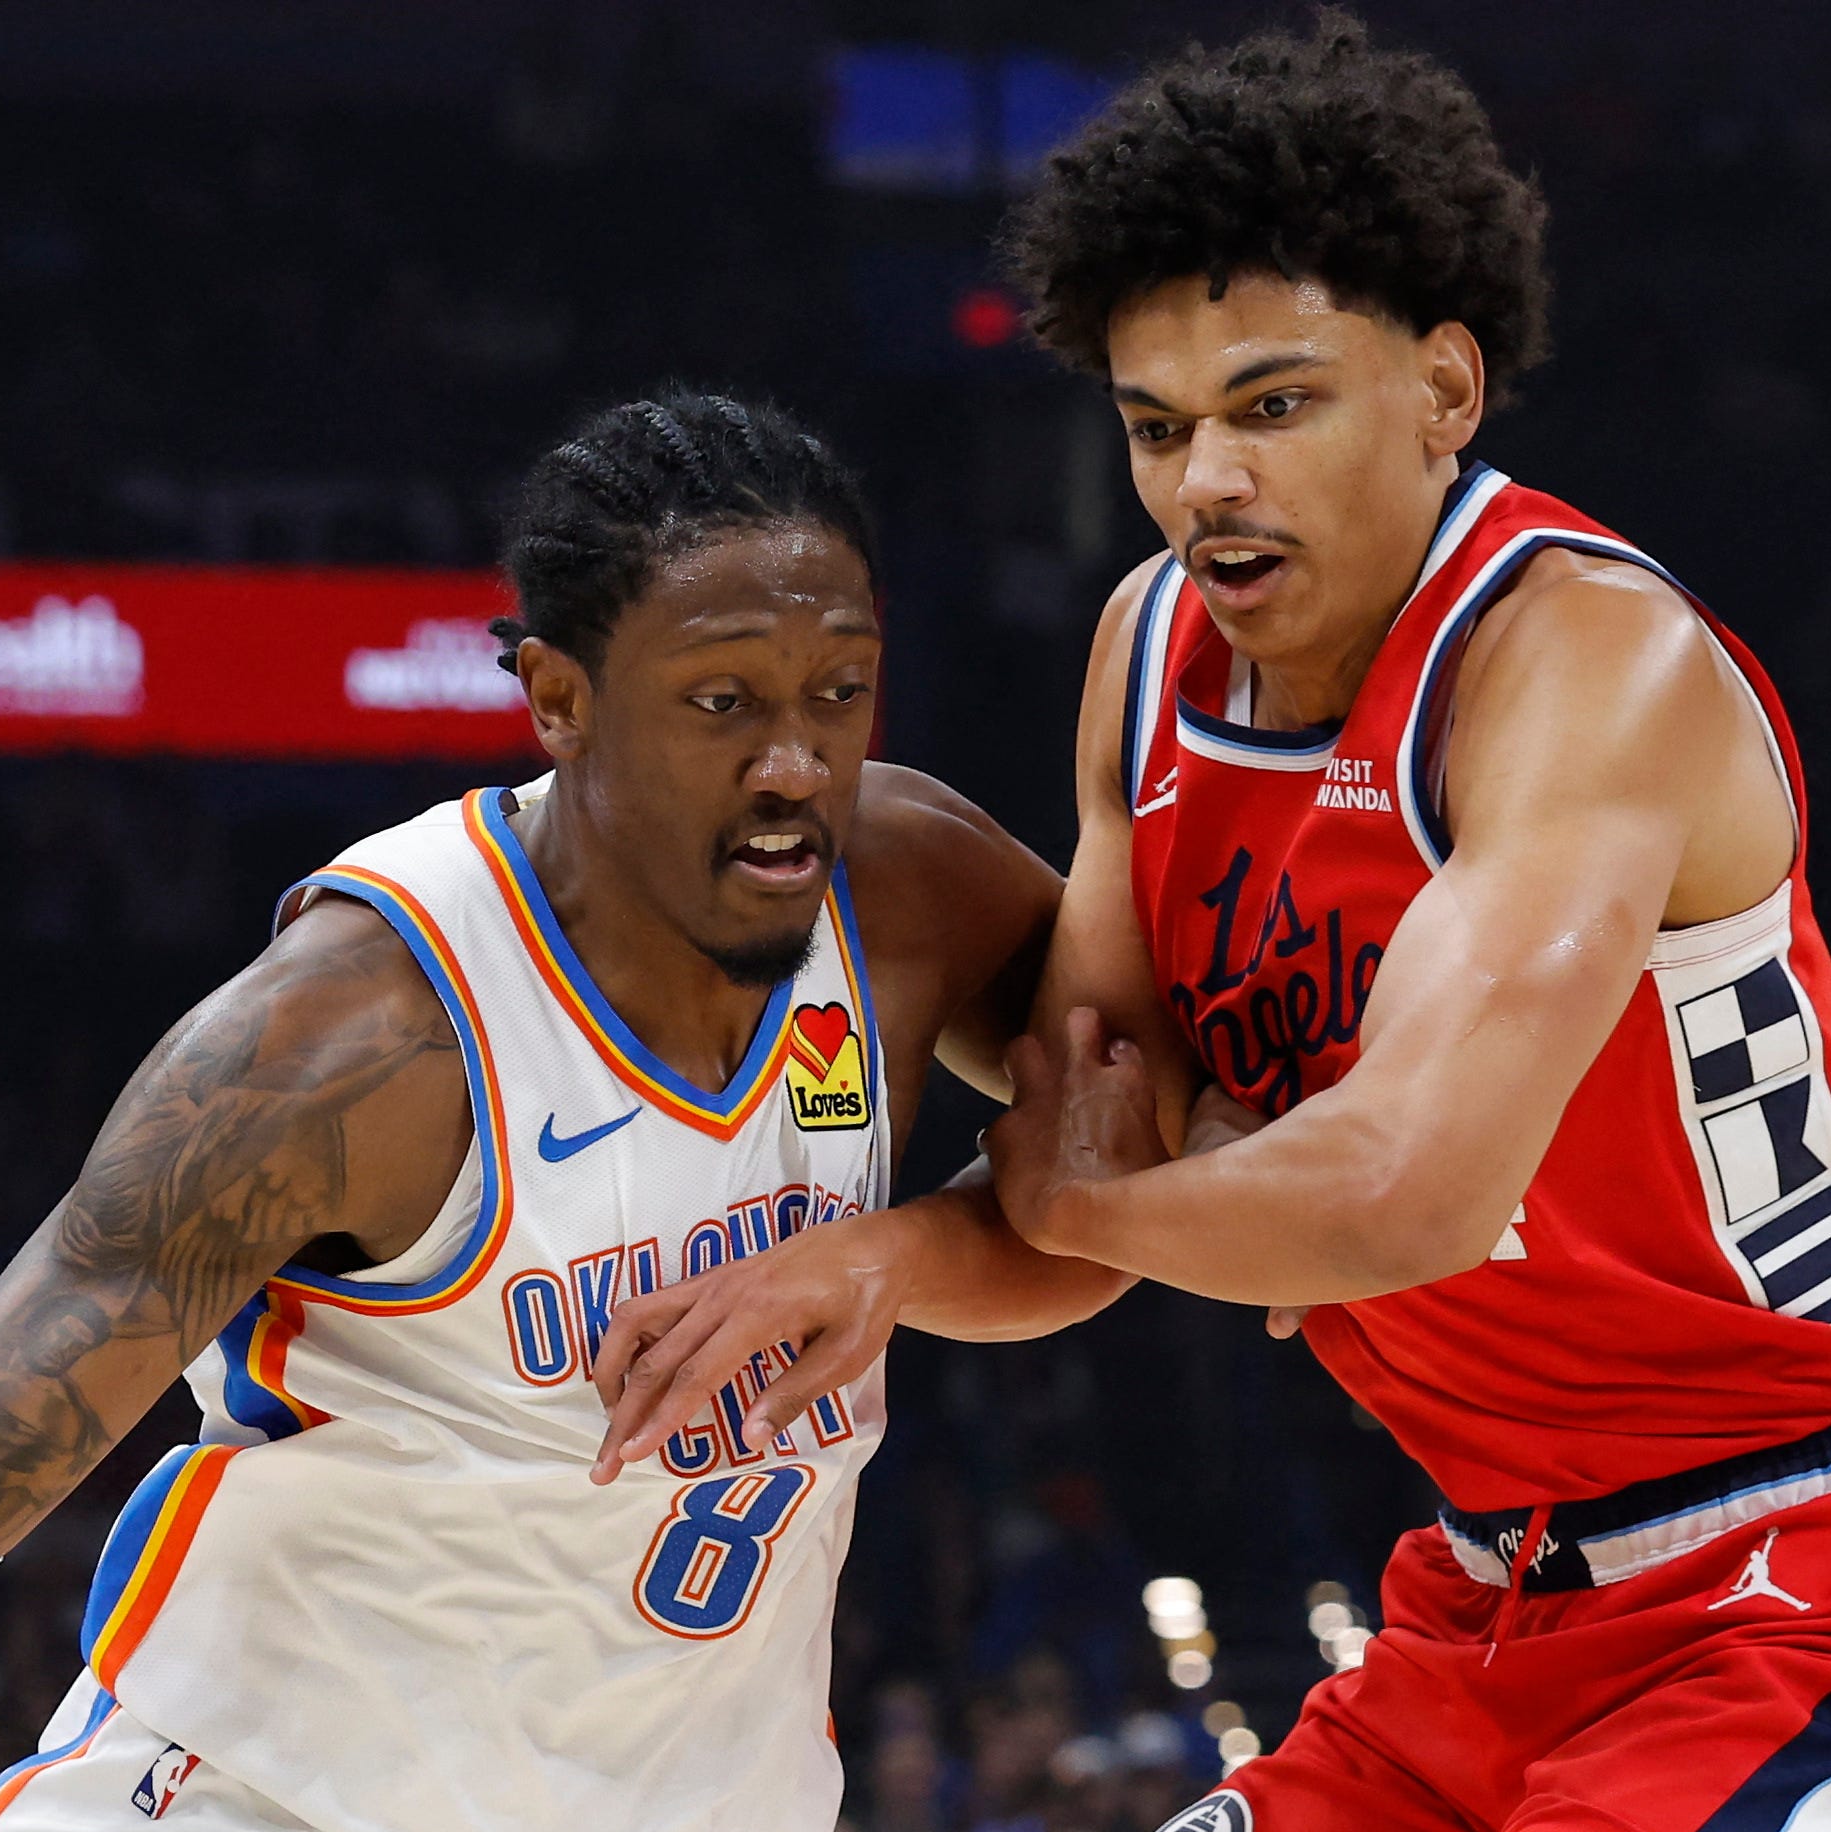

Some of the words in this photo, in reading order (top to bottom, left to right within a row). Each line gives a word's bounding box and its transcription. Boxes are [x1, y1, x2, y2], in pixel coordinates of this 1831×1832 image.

[1313, 783, 1393, 813] WANDA
[1198, 845, 1317, 995] Ls
[1169, 908, 1385, 1118] ngele
[632, 1463, 817, 1641] 8
[134, 1791, 154, 1812] NBA
